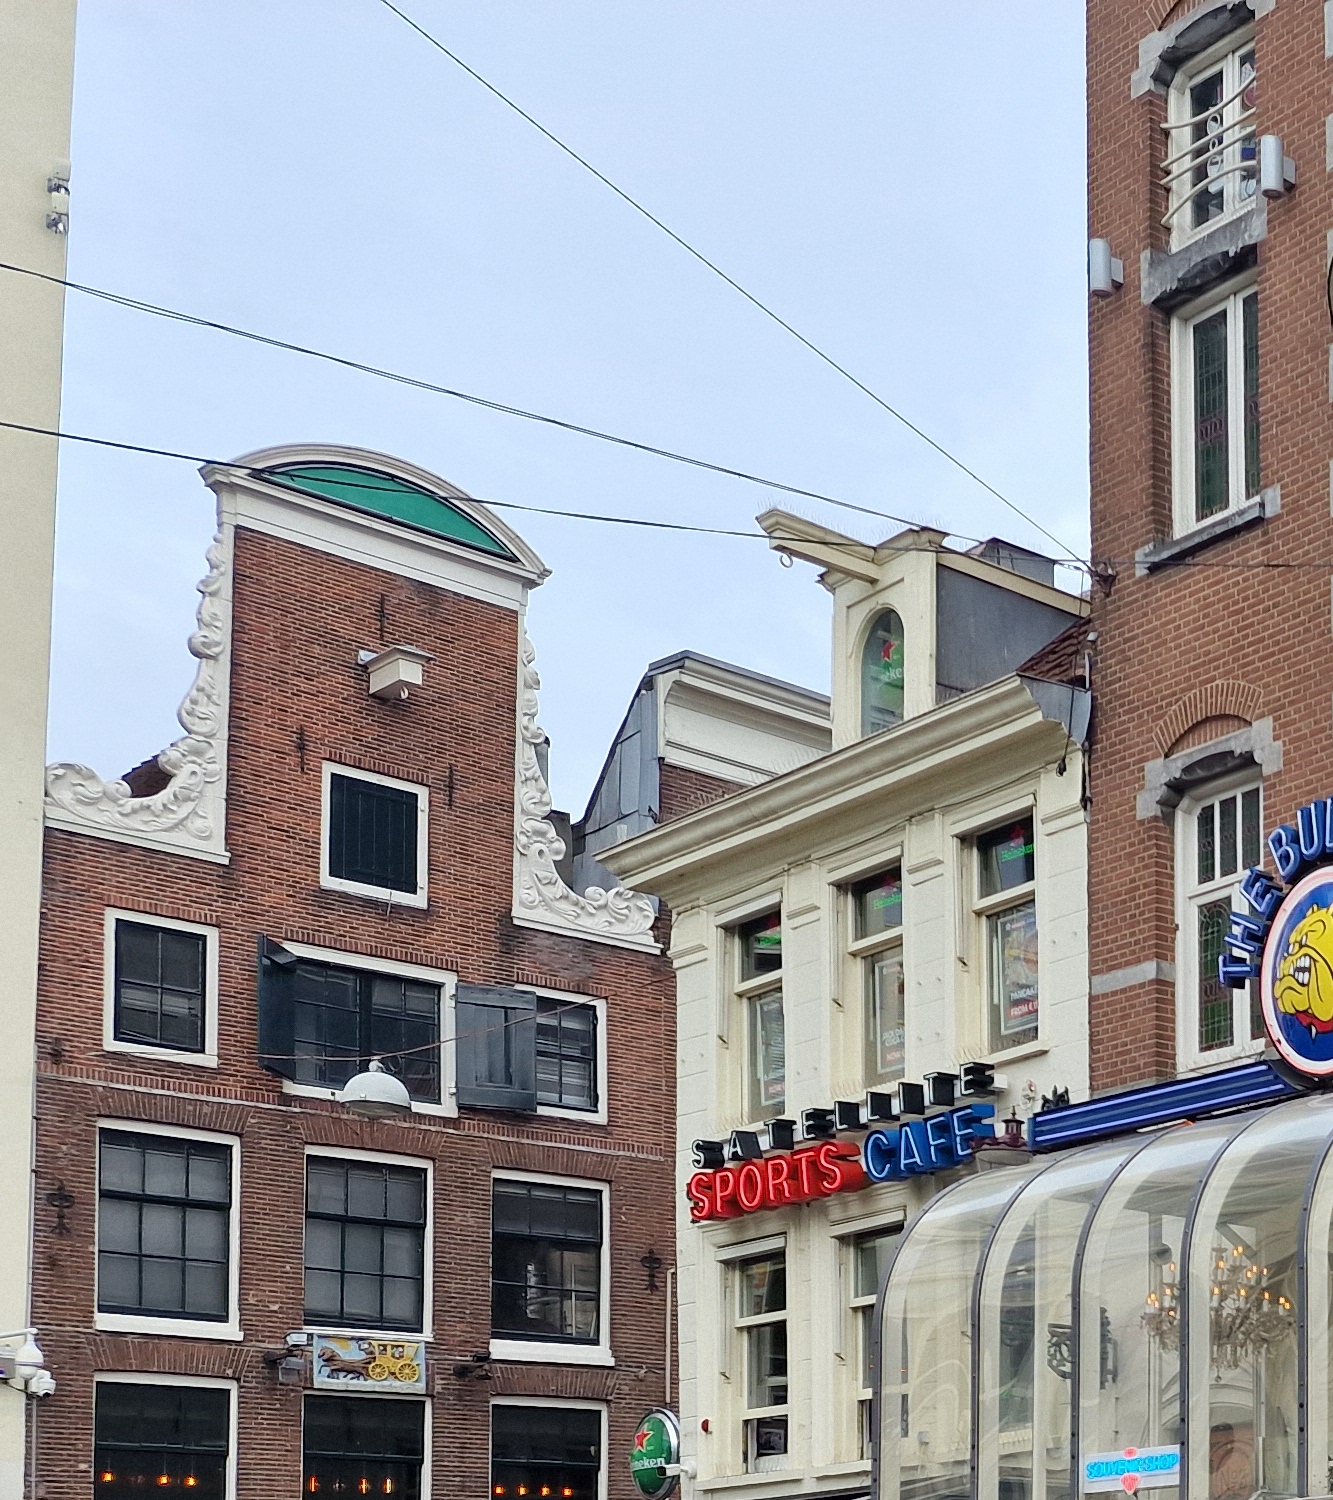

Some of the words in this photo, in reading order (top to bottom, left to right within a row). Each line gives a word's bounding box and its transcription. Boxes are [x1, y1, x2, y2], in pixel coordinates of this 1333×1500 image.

[1218, 866, 1286, 989] THE
[687, 1141, 862, 1220] SPORTS
[864, 1103, 995, 1184] CAFE
[691, 1062, 995, 1169] SATELLITE
[1086, 1458, 1143, 1480] SOUVENIR
[1145, 1453, 1180, 1472] SHOP
